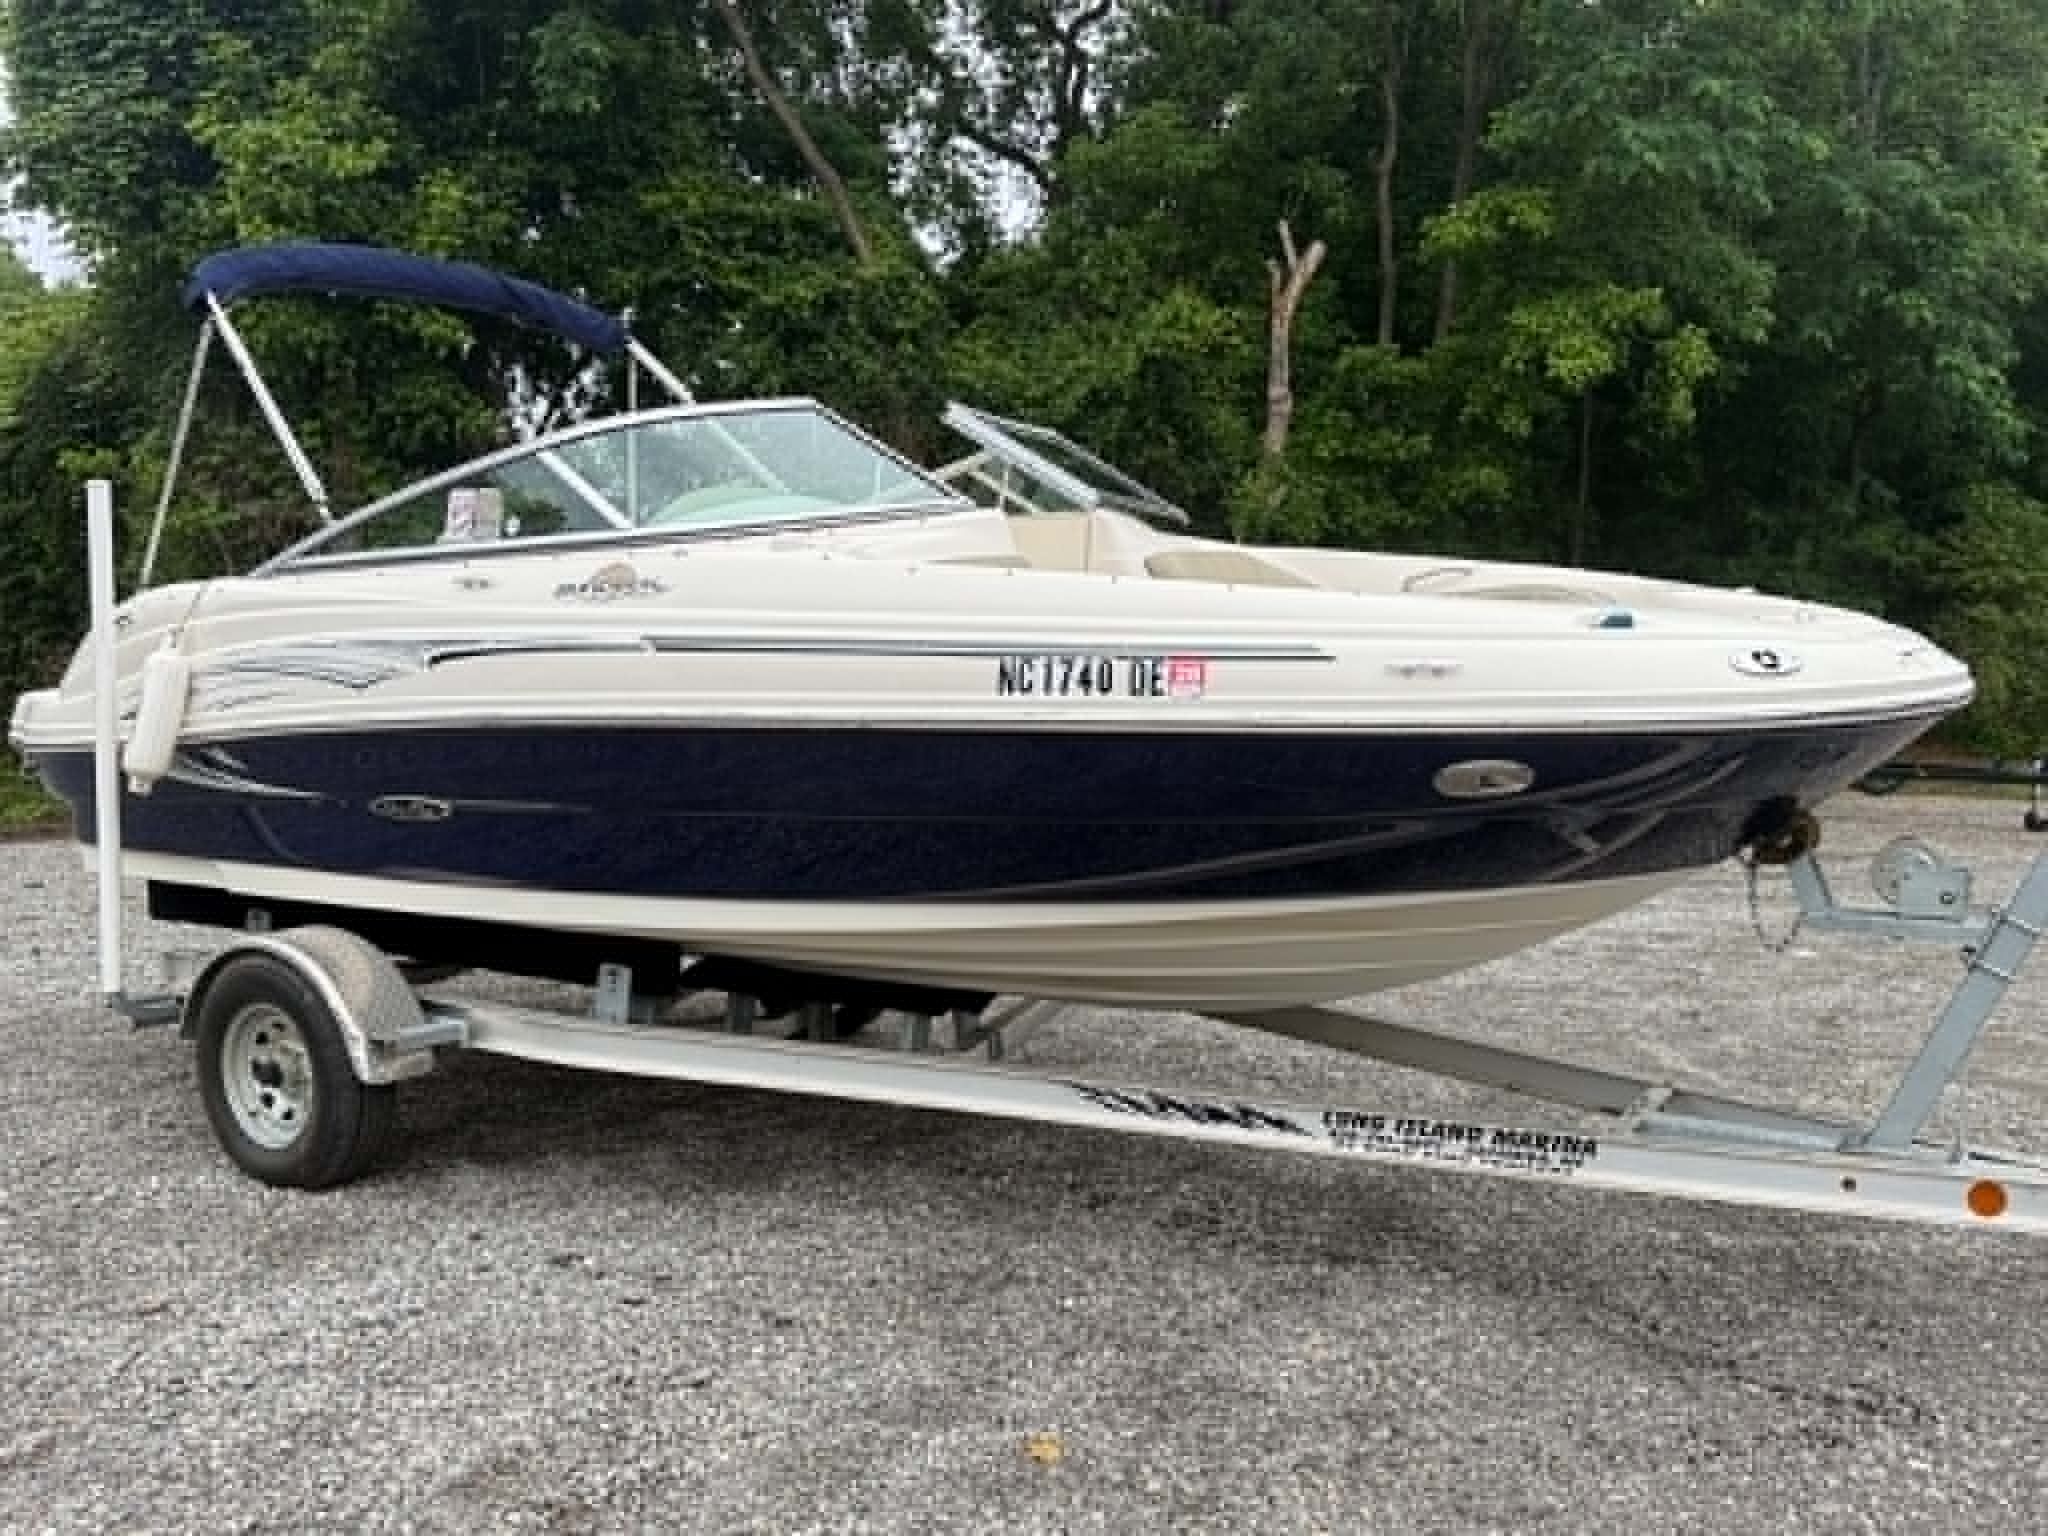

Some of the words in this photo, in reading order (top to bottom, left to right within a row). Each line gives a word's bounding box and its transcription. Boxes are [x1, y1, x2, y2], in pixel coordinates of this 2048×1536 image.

[1128, 655, 1166, 697] DE
[1393, 1117, 1486, 1143] ISLAND
[1491, 1127, 1598, 1158] MARINA
